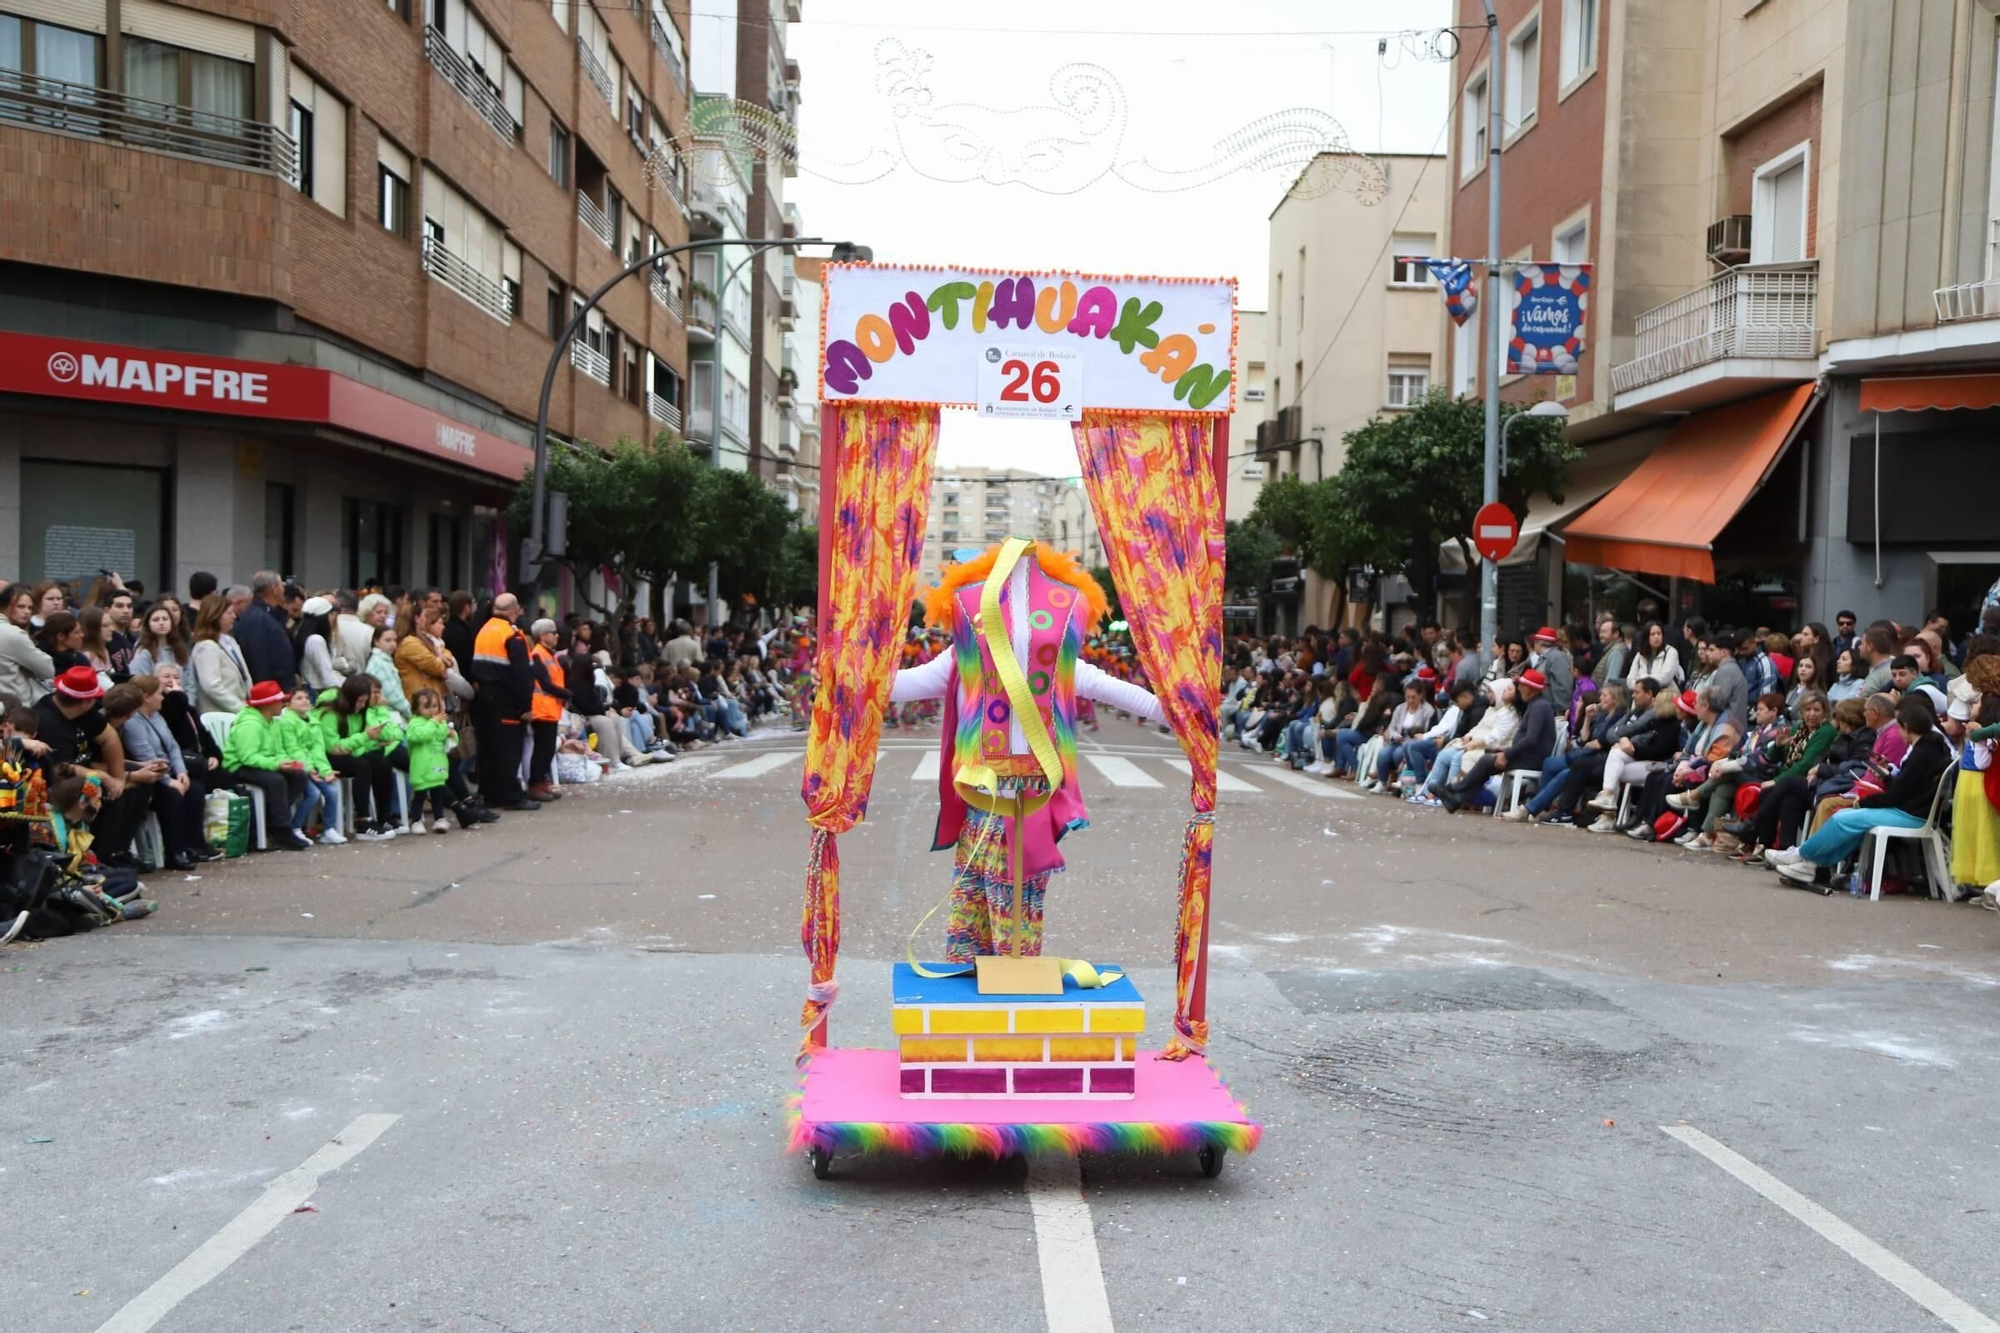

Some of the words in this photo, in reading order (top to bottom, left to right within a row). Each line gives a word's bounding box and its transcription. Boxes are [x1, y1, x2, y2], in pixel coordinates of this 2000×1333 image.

[1005, 349, 1036, 358] Carnaval
[1037, 350, 1046, 358] de
[1049, 351, 1077, 360] Badajoz
[81, 354, 267, 404] MAPFRE
[1000, 359, 1060, 403] 26
[441, 423, 475, 457] MAPFRE
